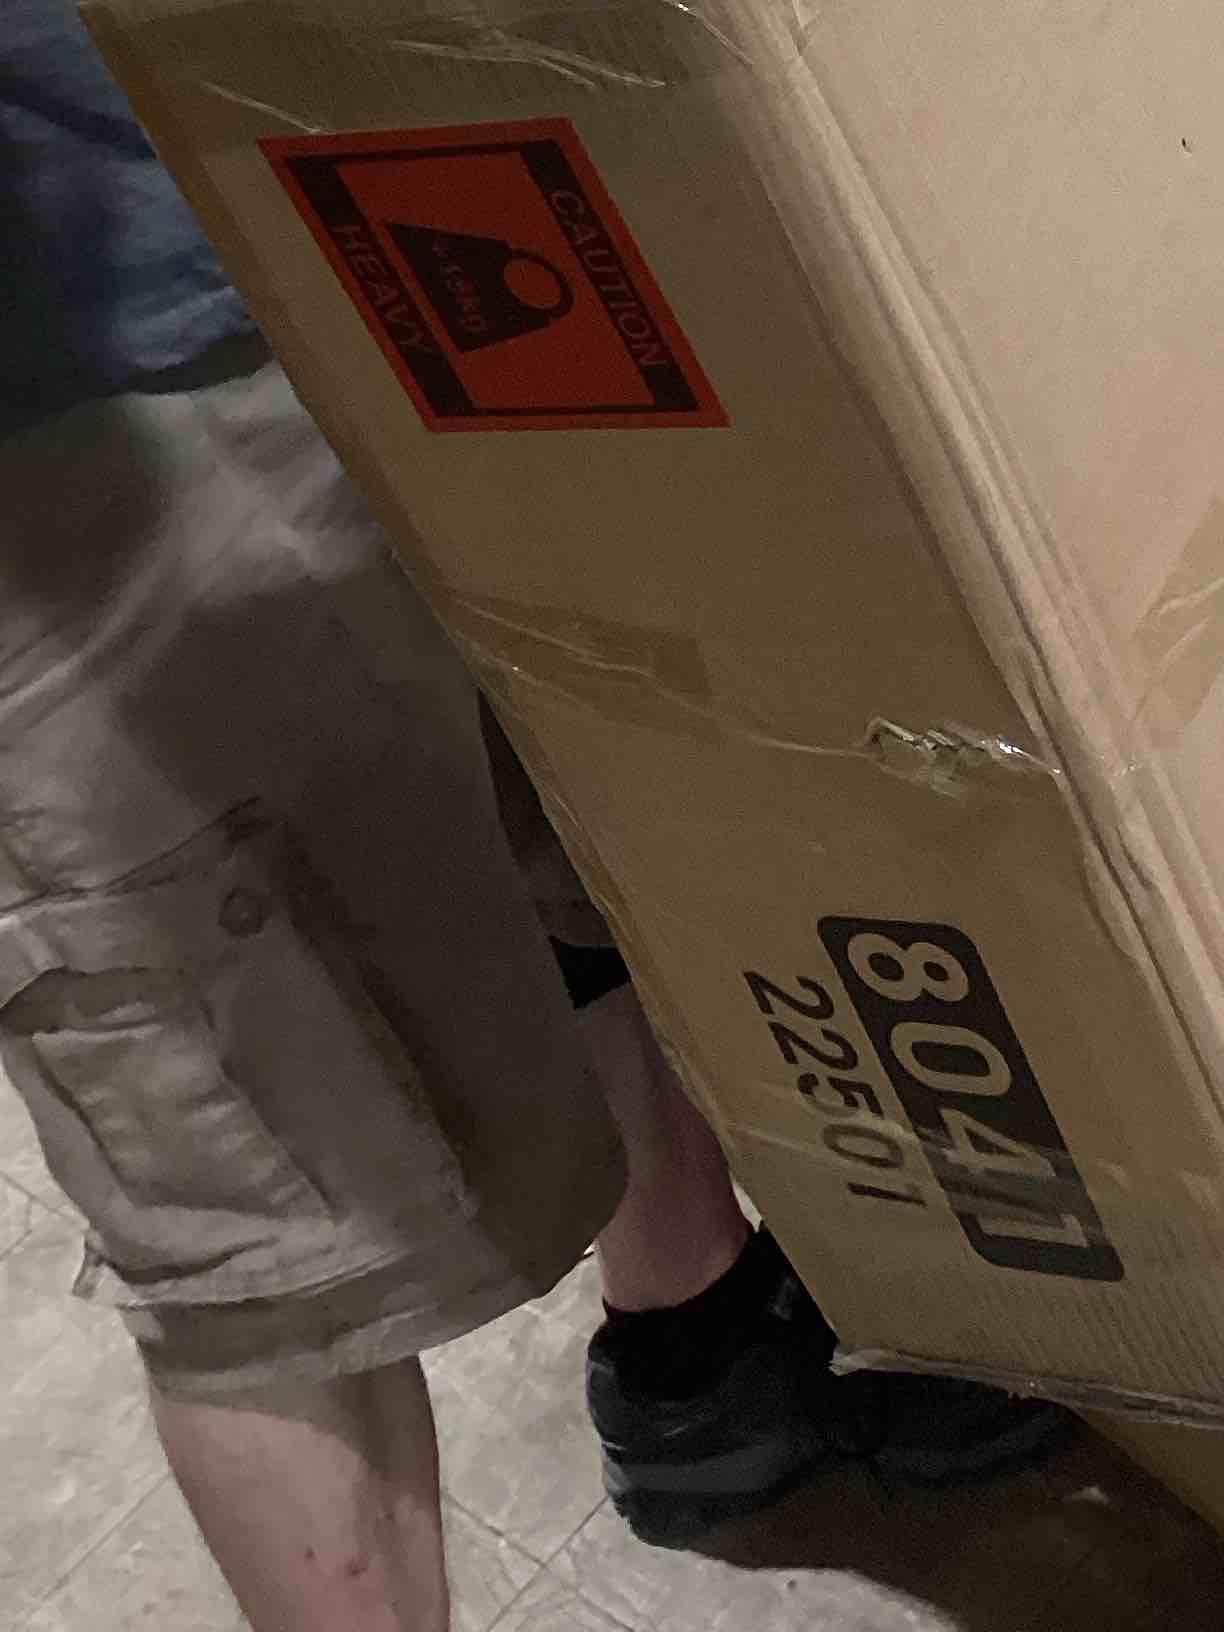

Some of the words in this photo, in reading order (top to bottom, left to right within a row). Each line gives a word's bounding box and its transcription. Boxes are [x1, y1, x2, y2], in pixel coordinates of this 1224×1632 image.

[331, 224, 436, 356] HEAVY
[550, 189, 669, 371] CAUTION
[743, 970, 929, 1208] 22501
[846, 932, 1089, 1248] 8041
